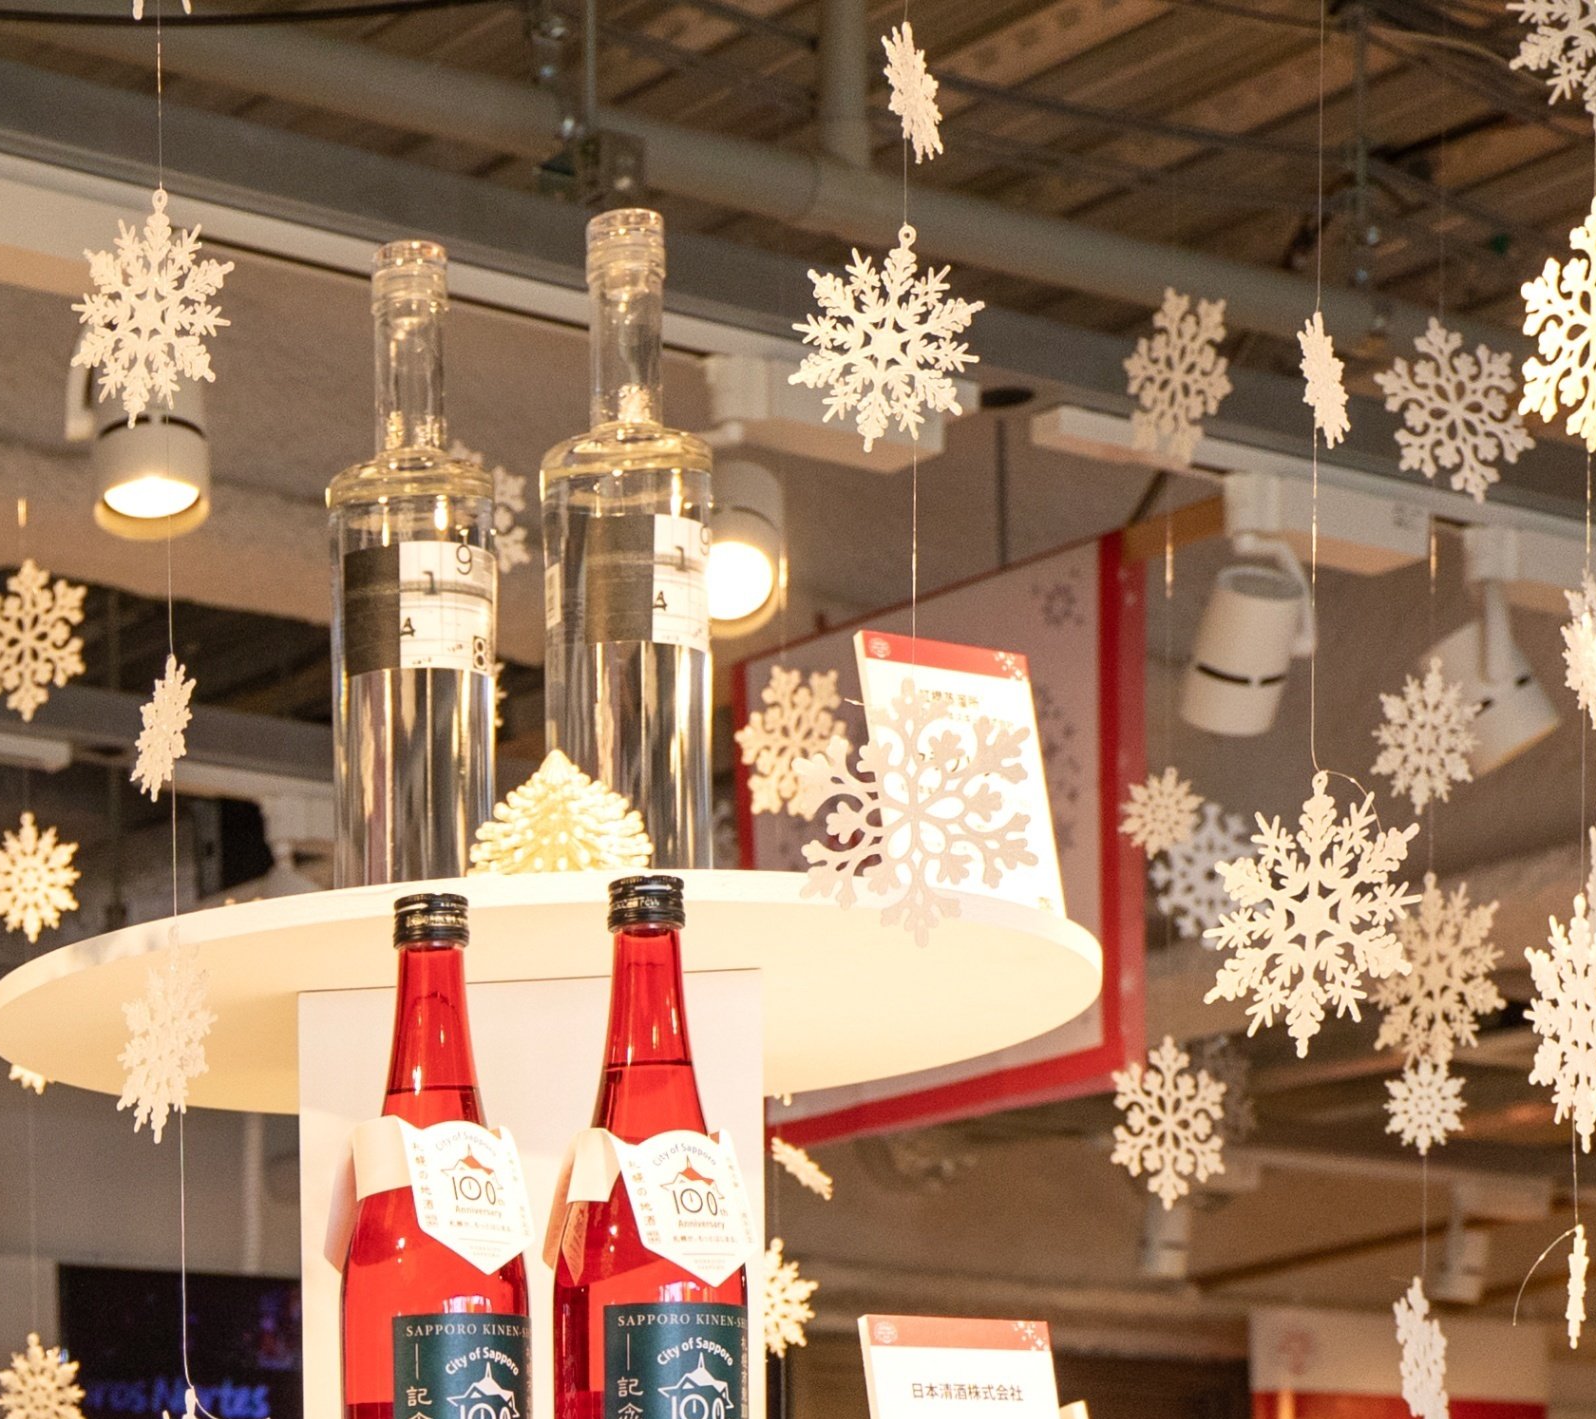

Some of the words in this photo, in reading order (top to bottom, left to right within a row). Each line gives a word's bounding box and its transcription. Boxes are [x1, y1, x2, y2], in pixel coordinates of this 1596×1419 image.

[455, 544, 473, 575] 9
[456, 1205, 502, 1218] Anniversary
[678, 1220, 725, 1230] Anniversary
[618, 1314, 690, 1327] SAPPORO
[406, 1323, 477, 1337] SAPPORO
[656, 1347, 679, 1366] City
[681, 1337, 694, 1351] of
[695, 1336, 734, 1367] Sapporo
[445, 1356, 468, 1376] City
[469, 1347, 481, 1360] of
[482, 1346, 520, 1376] Sapporo
[911, 1382, 1024, 1402] 日本清酒株式会社
